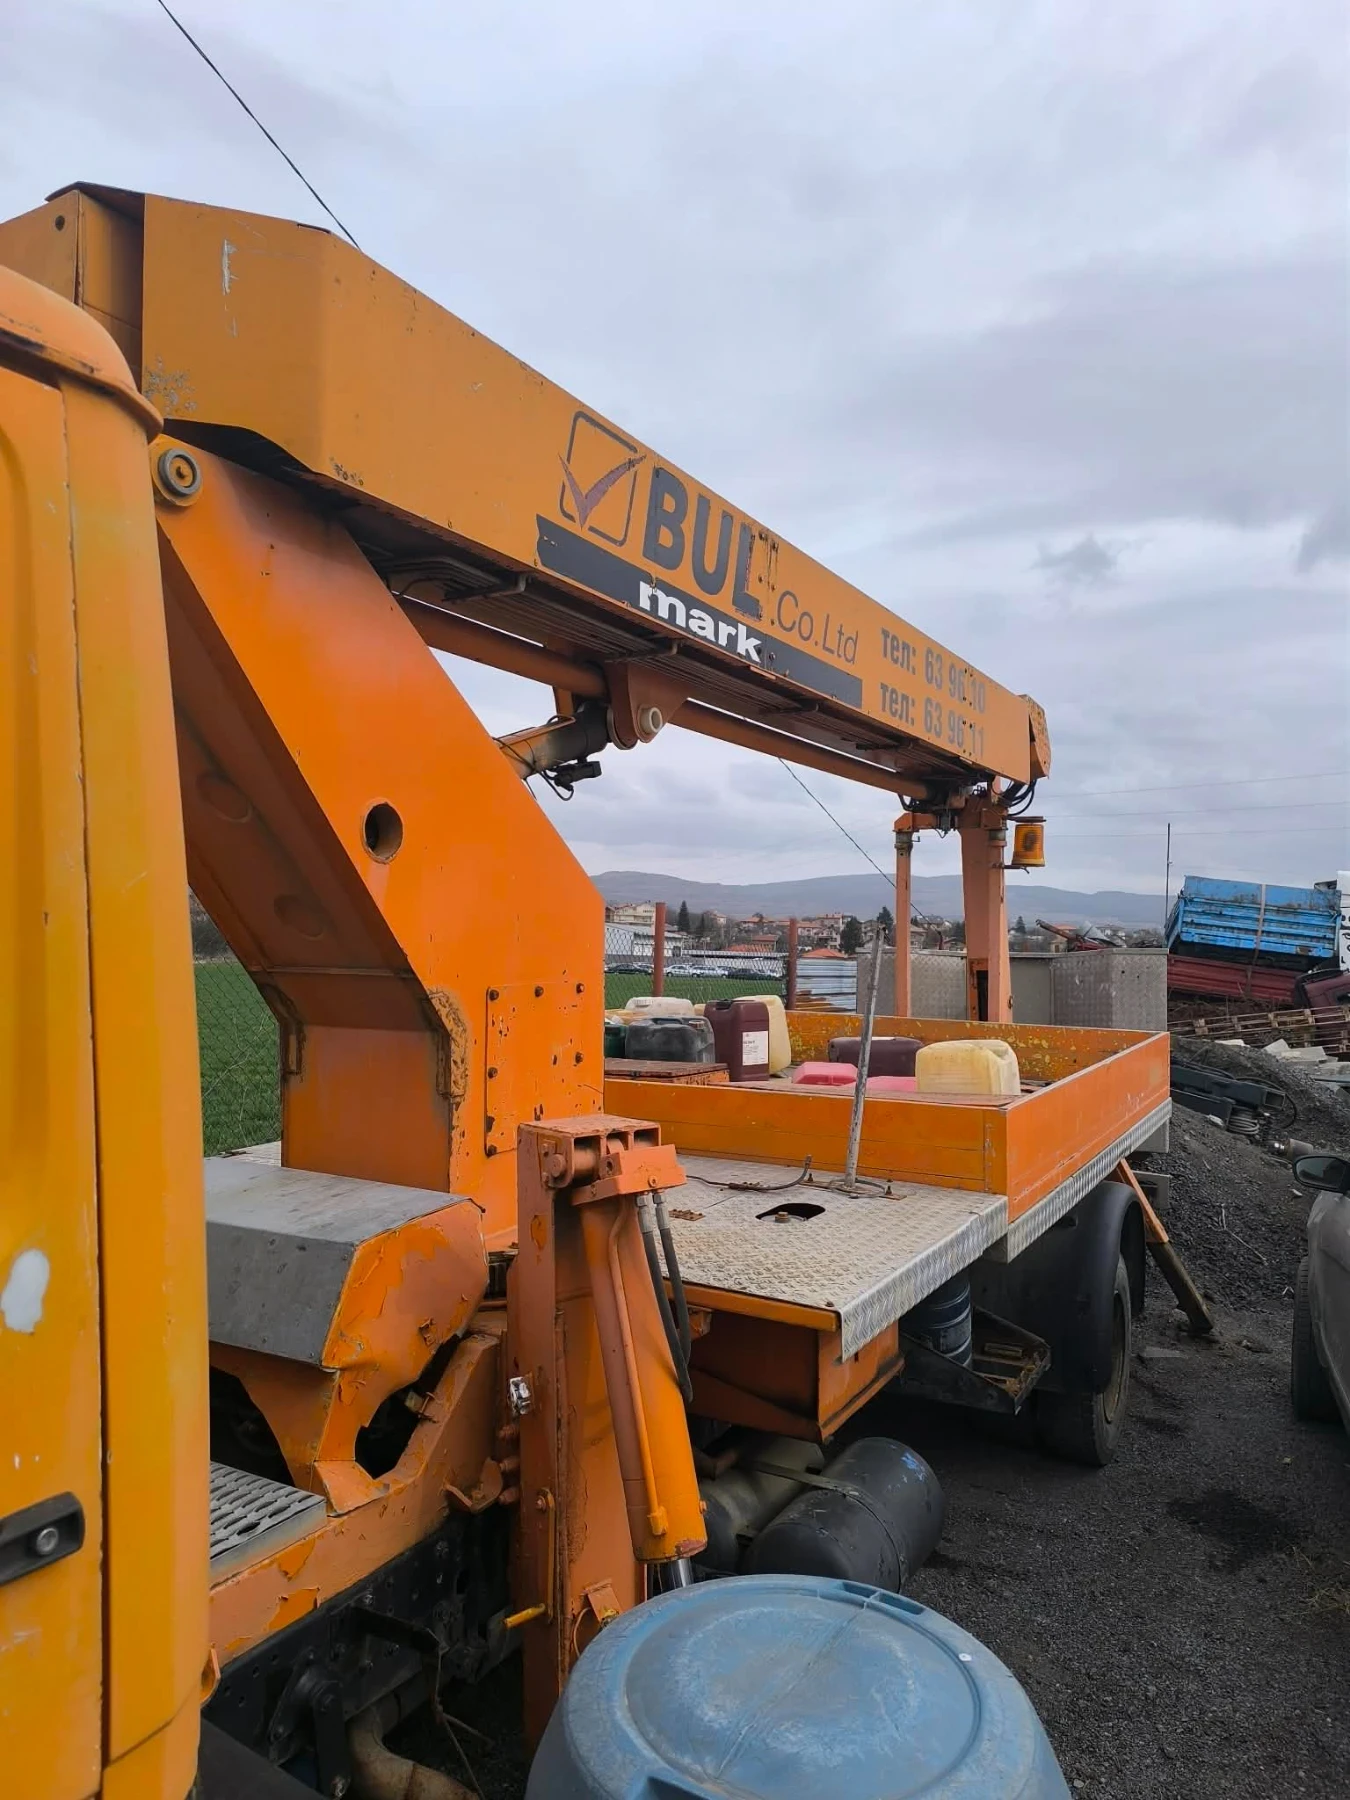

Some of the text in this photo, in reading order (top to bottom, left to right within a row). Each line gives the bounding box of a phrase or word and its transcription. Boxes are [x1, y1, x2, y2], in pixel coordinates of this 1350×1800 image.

[643, 466, 763, 621] BUL
[639, 581, 762, 663] mark
[925, 647, 943, 690] 63
[948, 662, 965, 704] 96
[924, 697, 942, 738] 63
[947, 710, 964, 748] 96
